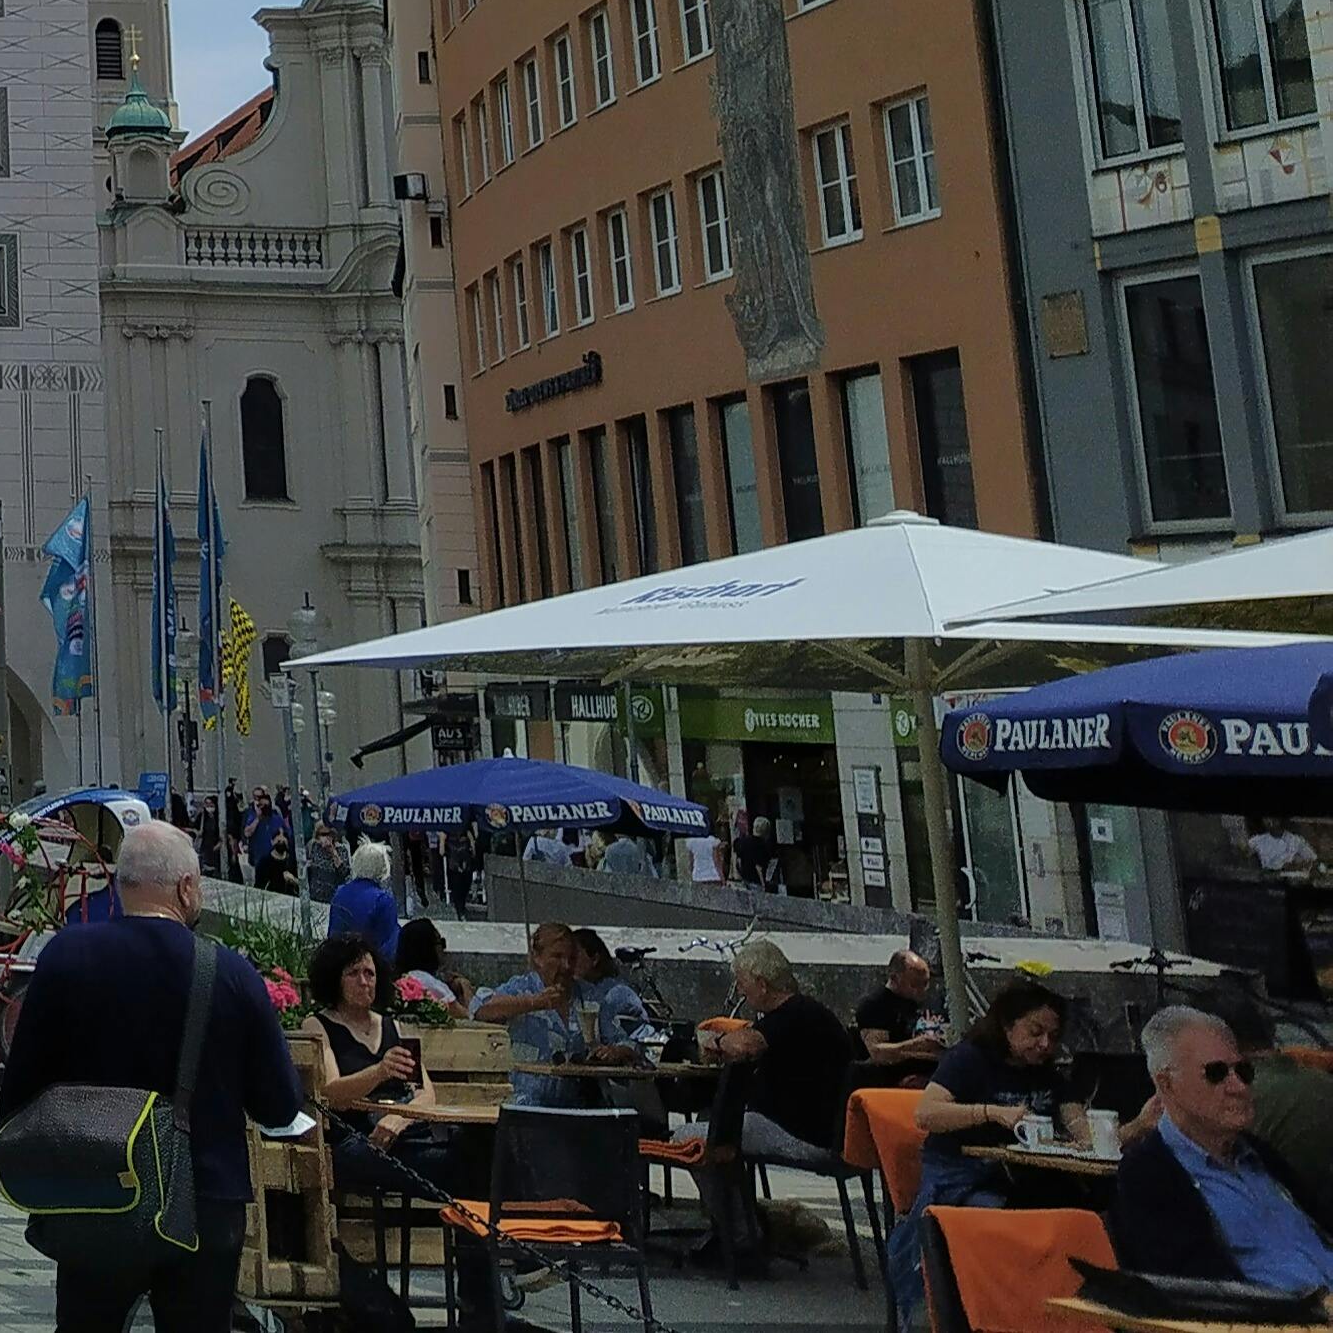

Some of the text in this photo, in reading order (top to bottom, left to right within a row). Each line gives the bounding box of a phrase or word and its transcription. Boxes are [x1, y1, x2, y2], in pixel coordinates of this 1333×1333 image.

[571, 695, 618, 718] HALLHUB
[779, 712, 821, 729] ROCHER
[993, 713, 1112, 752] PAULANER
[1220, 718, 1333, 756] PAU
[384, 805, 463, 824] PAULANER
[508, 800, 613, 822] PAULANER
[643, 803, 707, 828] PAULANER
